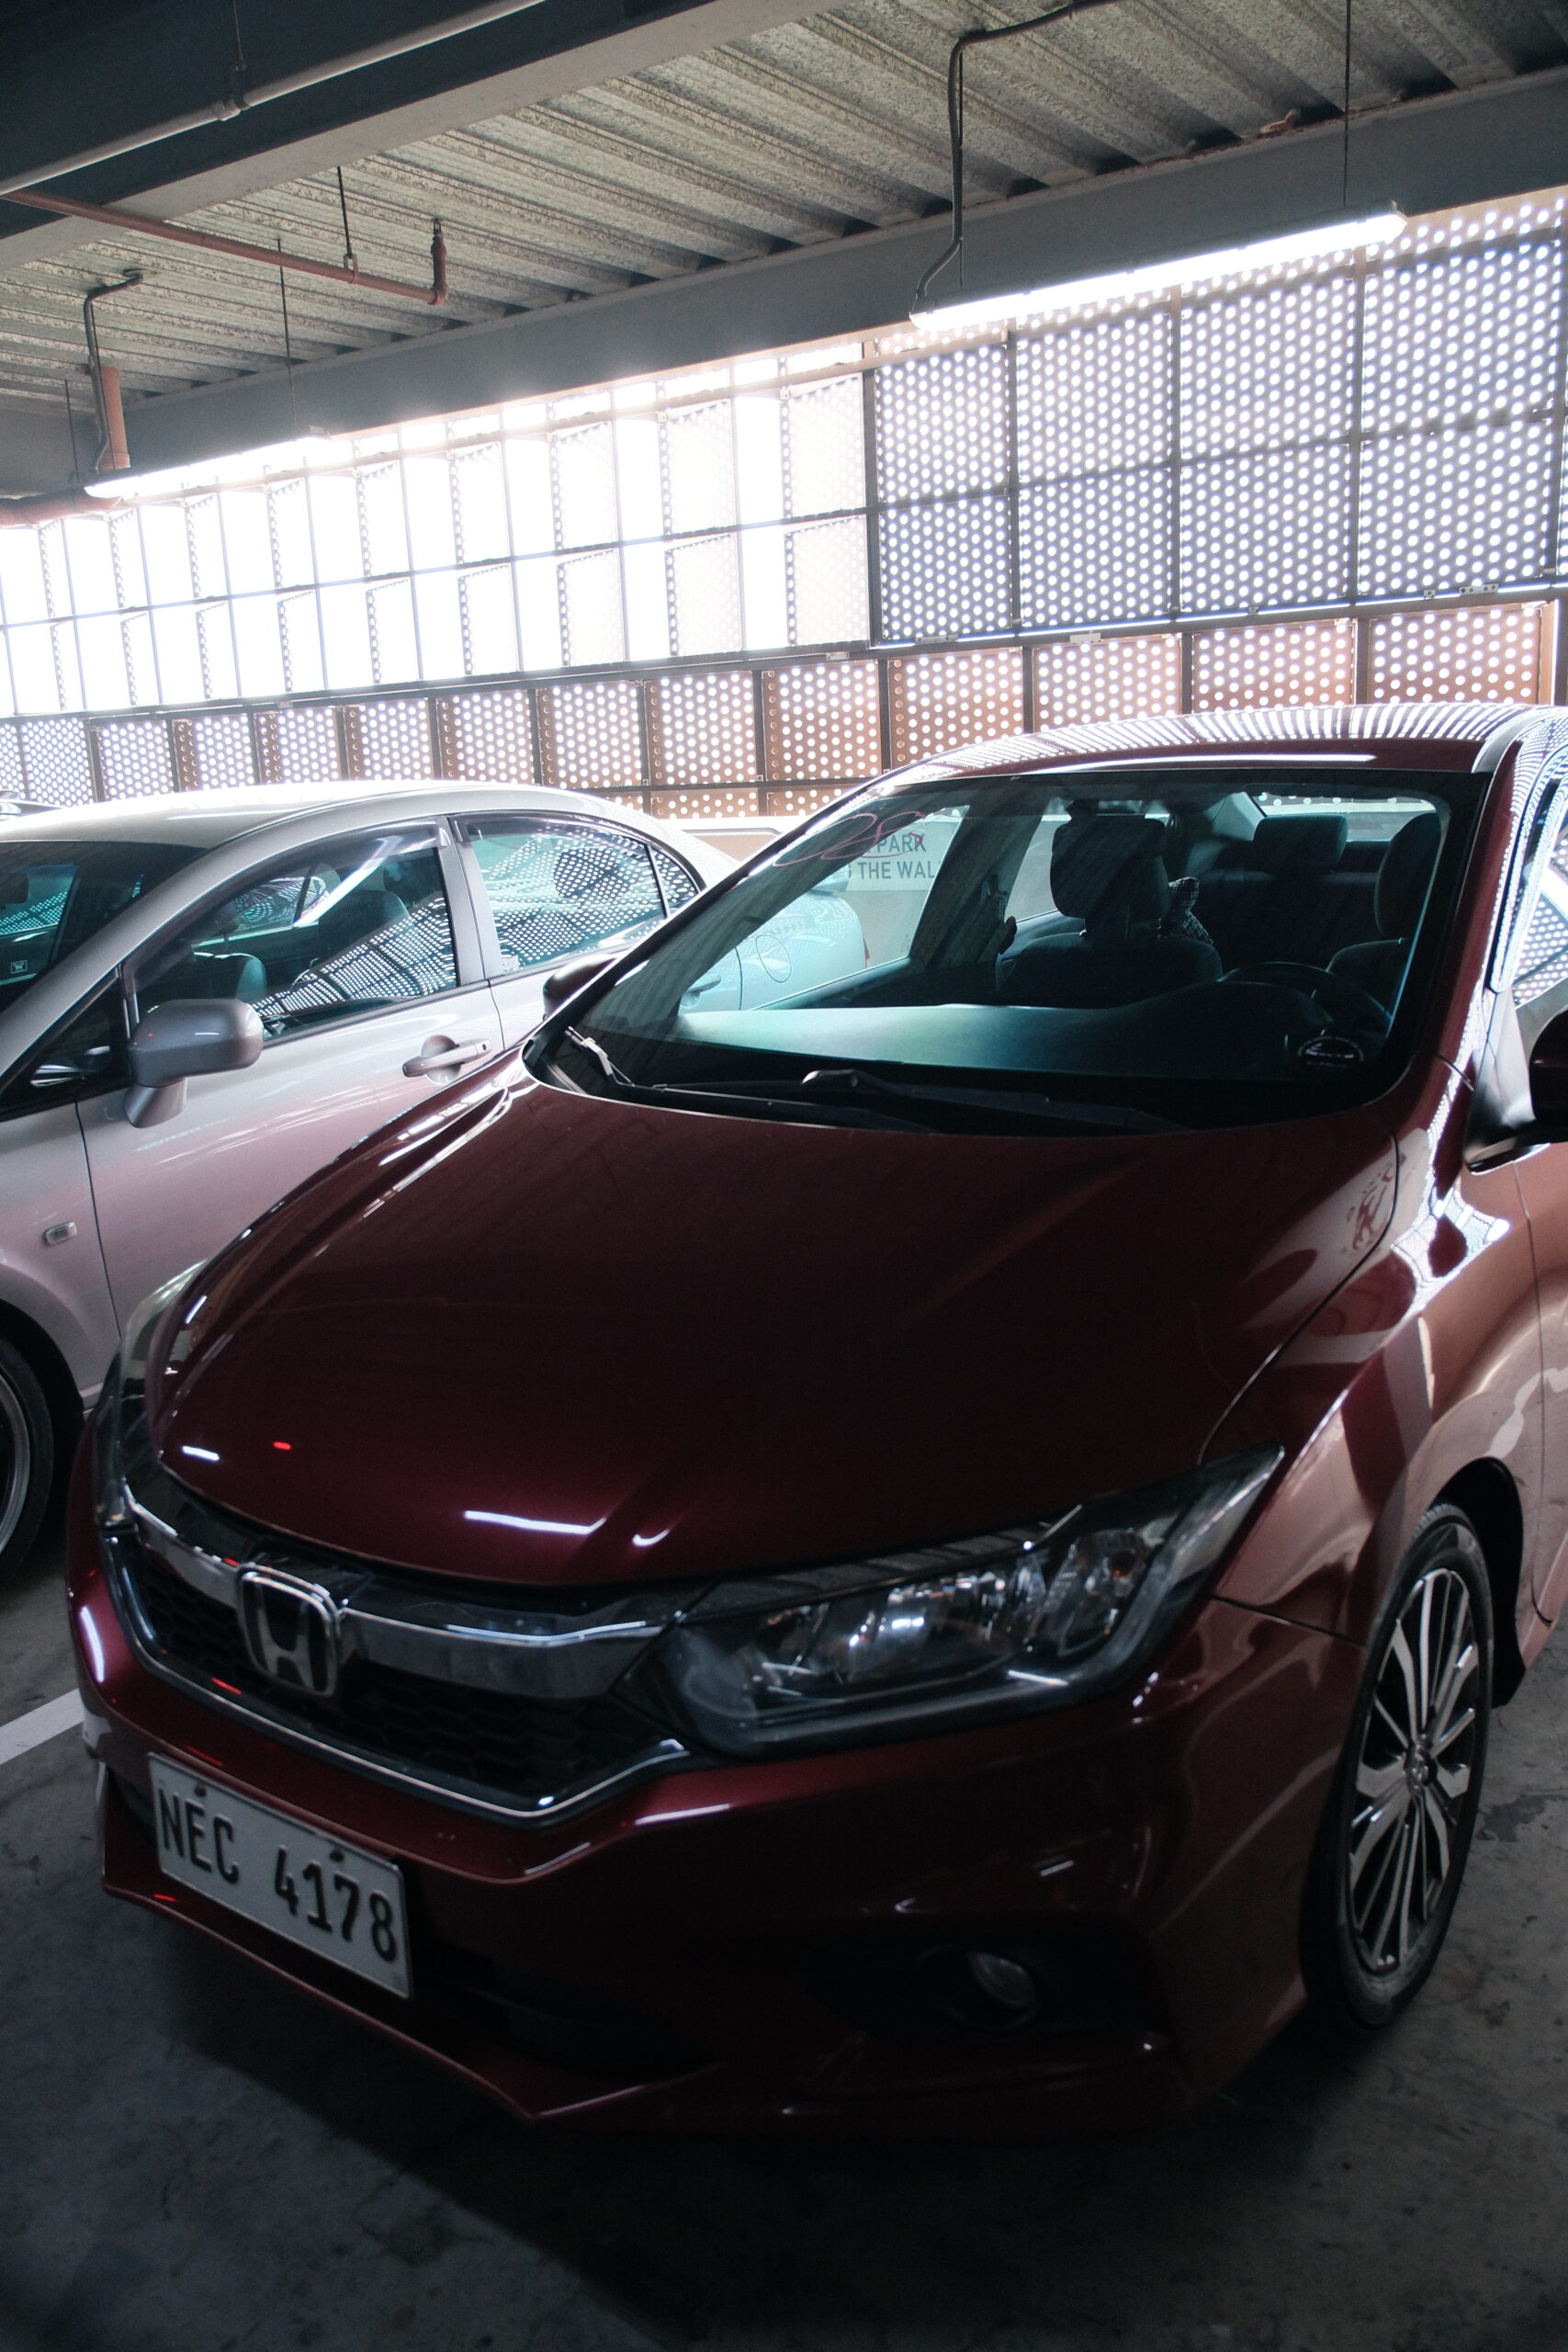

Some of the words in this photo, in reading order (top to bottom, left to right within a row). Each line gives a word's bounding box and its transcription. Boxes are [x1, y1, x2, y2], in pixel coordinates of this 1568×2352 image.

[856, 861, 891, 879] THE
[897, 860, 941, 879] WAL
[157, 1787, 240, 1884] NEC
[275, 1843, 398, 1963] 4178
